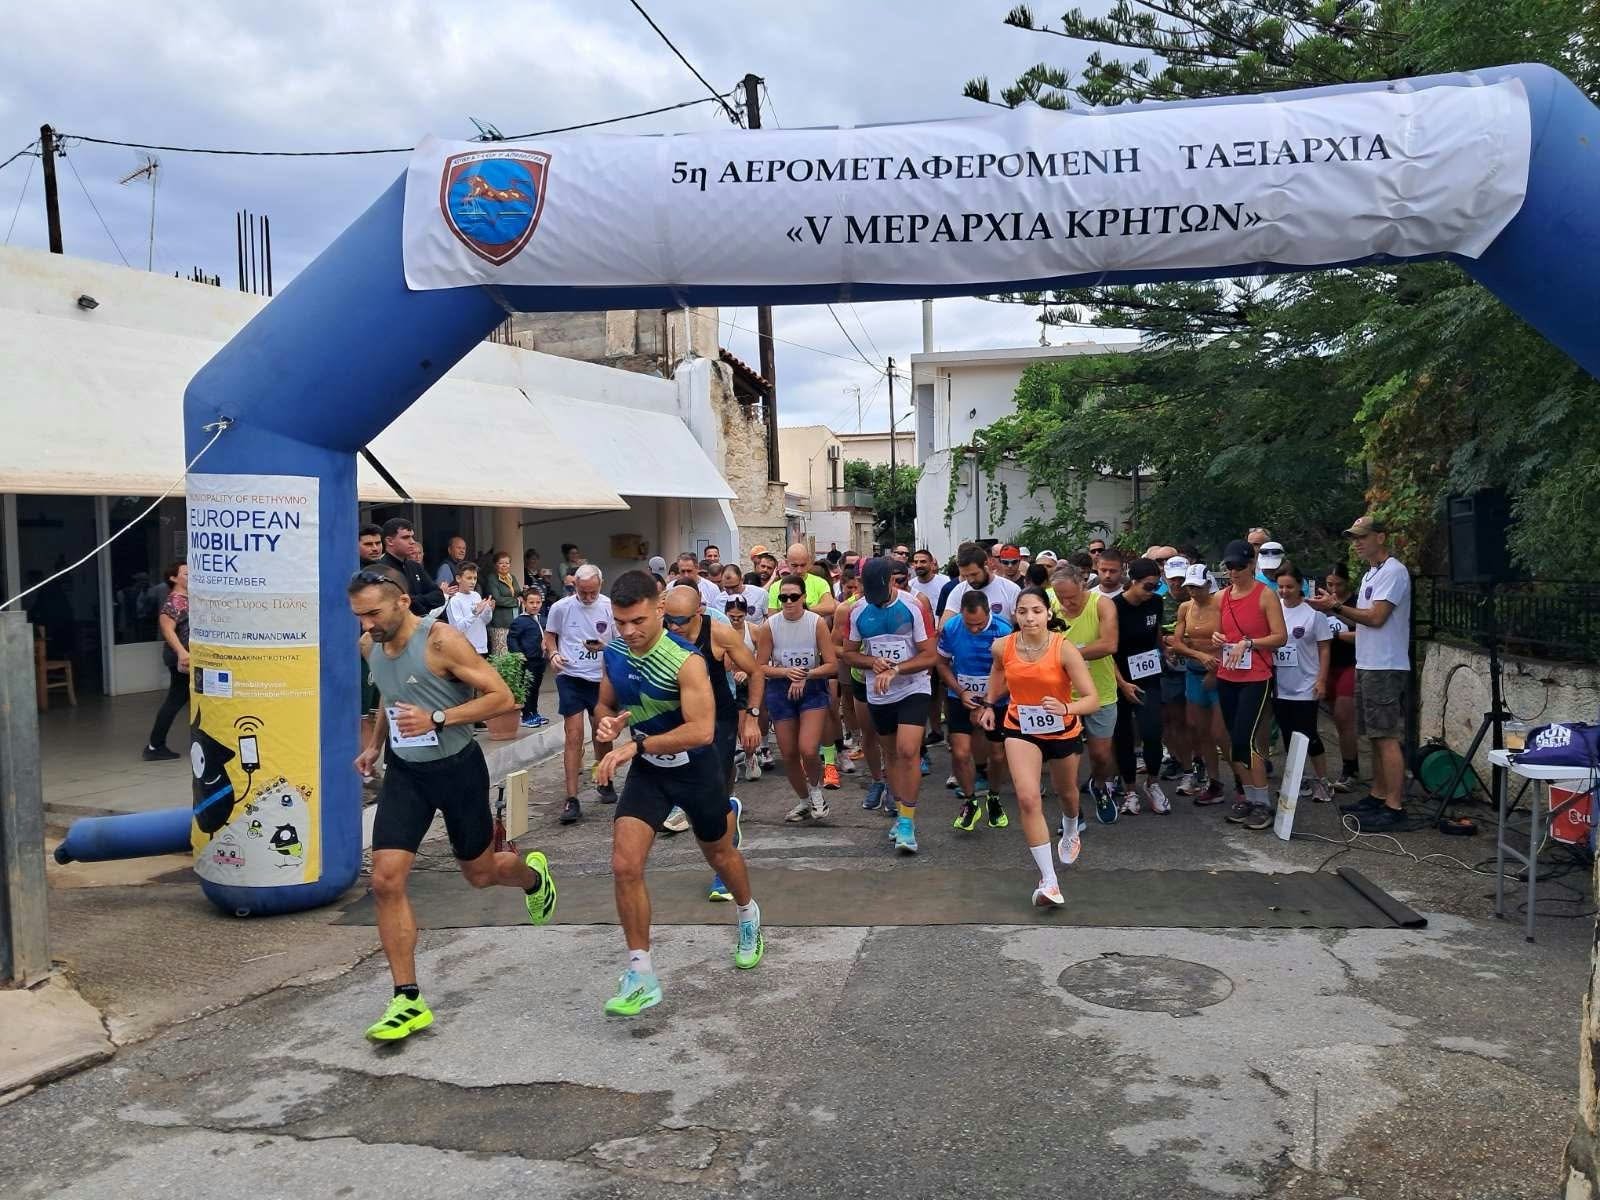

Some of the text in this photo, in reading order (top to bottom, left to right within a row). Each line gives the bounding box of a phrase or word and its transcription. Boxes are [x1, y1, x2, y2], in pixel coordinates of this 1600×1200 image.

[671, 133, 1393, 191] 5η ΑΕΡΟΜΕΤΑΦΕΡΟΜΕΝΗ ΤΑΞΙΑΡΧΙΑ
[844, 211, 1055, 245] ΜΕΡΑΡΧΙΑ
[1064, 202, 1263, 240] ΚΡΗΤΩΝ»
[235, 494, 249, 503] OF
[251, 495, 307, 505] RETHYMNO
[190, 508, 300, 529] EUROPEAN
[191, 531, 281, 552] MOBILITY
[191, 553, 238, 573] WEEK
[206, 576, 266, 587] SEPTEMBER
[241, 631, 307, 641] #RUNANDWALK
[578, 650, 598, 660] 240
[879, 649, 900, 660] 175
[788, 656, 809, 667] 193
[1135, 660, 1155, 672] 160
[964, 682, 986, 692] 207
[1027, 714, 1055, 728] 189
